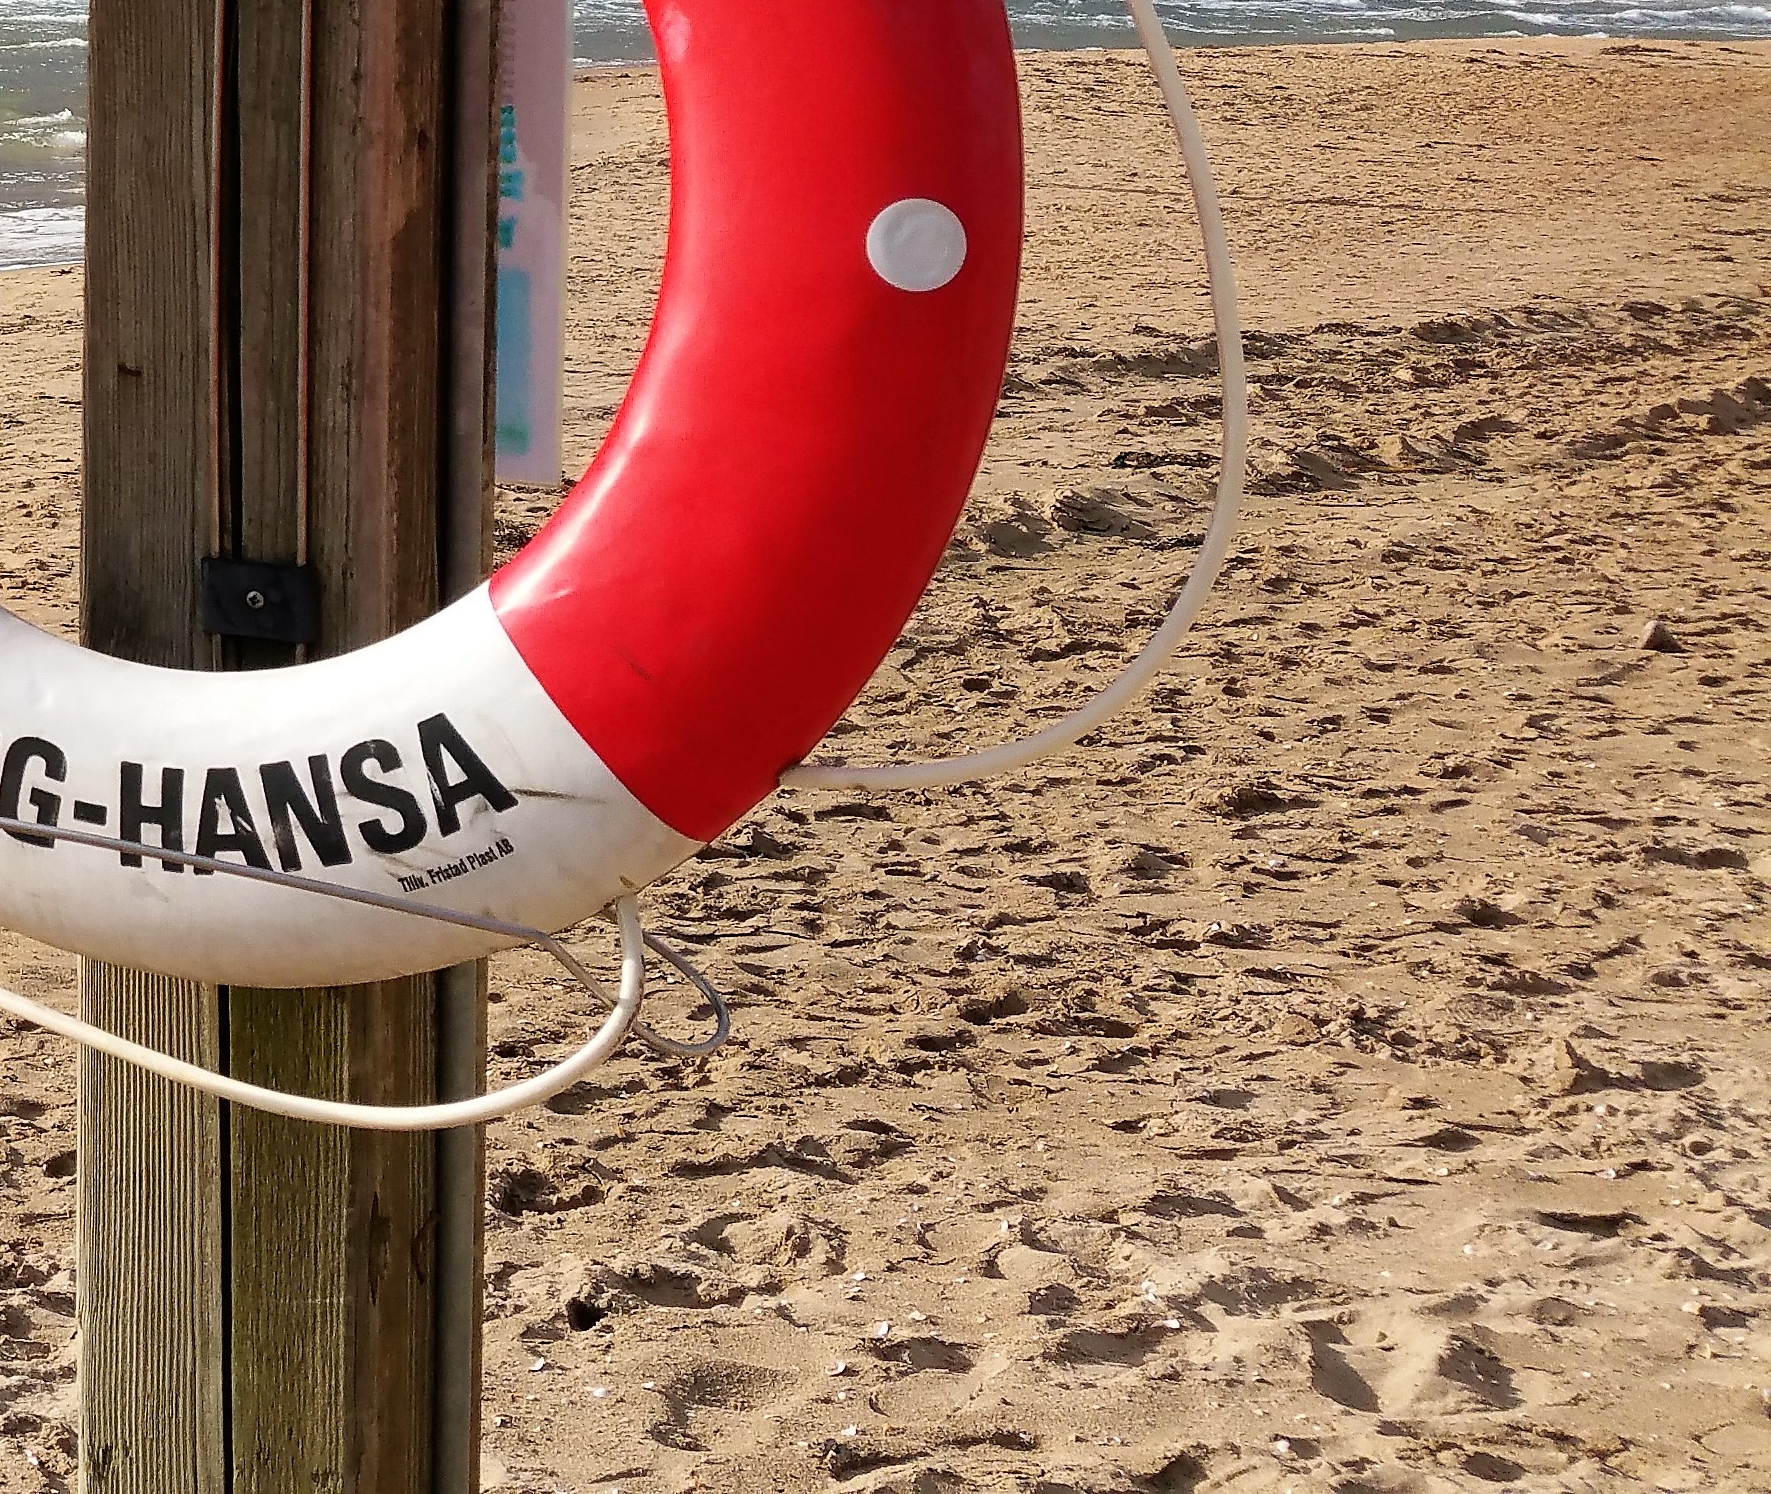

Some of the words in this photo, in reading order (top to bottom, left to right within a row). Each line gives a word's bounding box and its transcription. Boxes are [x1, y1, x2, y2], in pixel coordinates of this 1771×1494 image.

[426, 858, 469, 885] Fristad
[466, 846, 498, 870] Plast
[495, 838, 514, 858] AB
